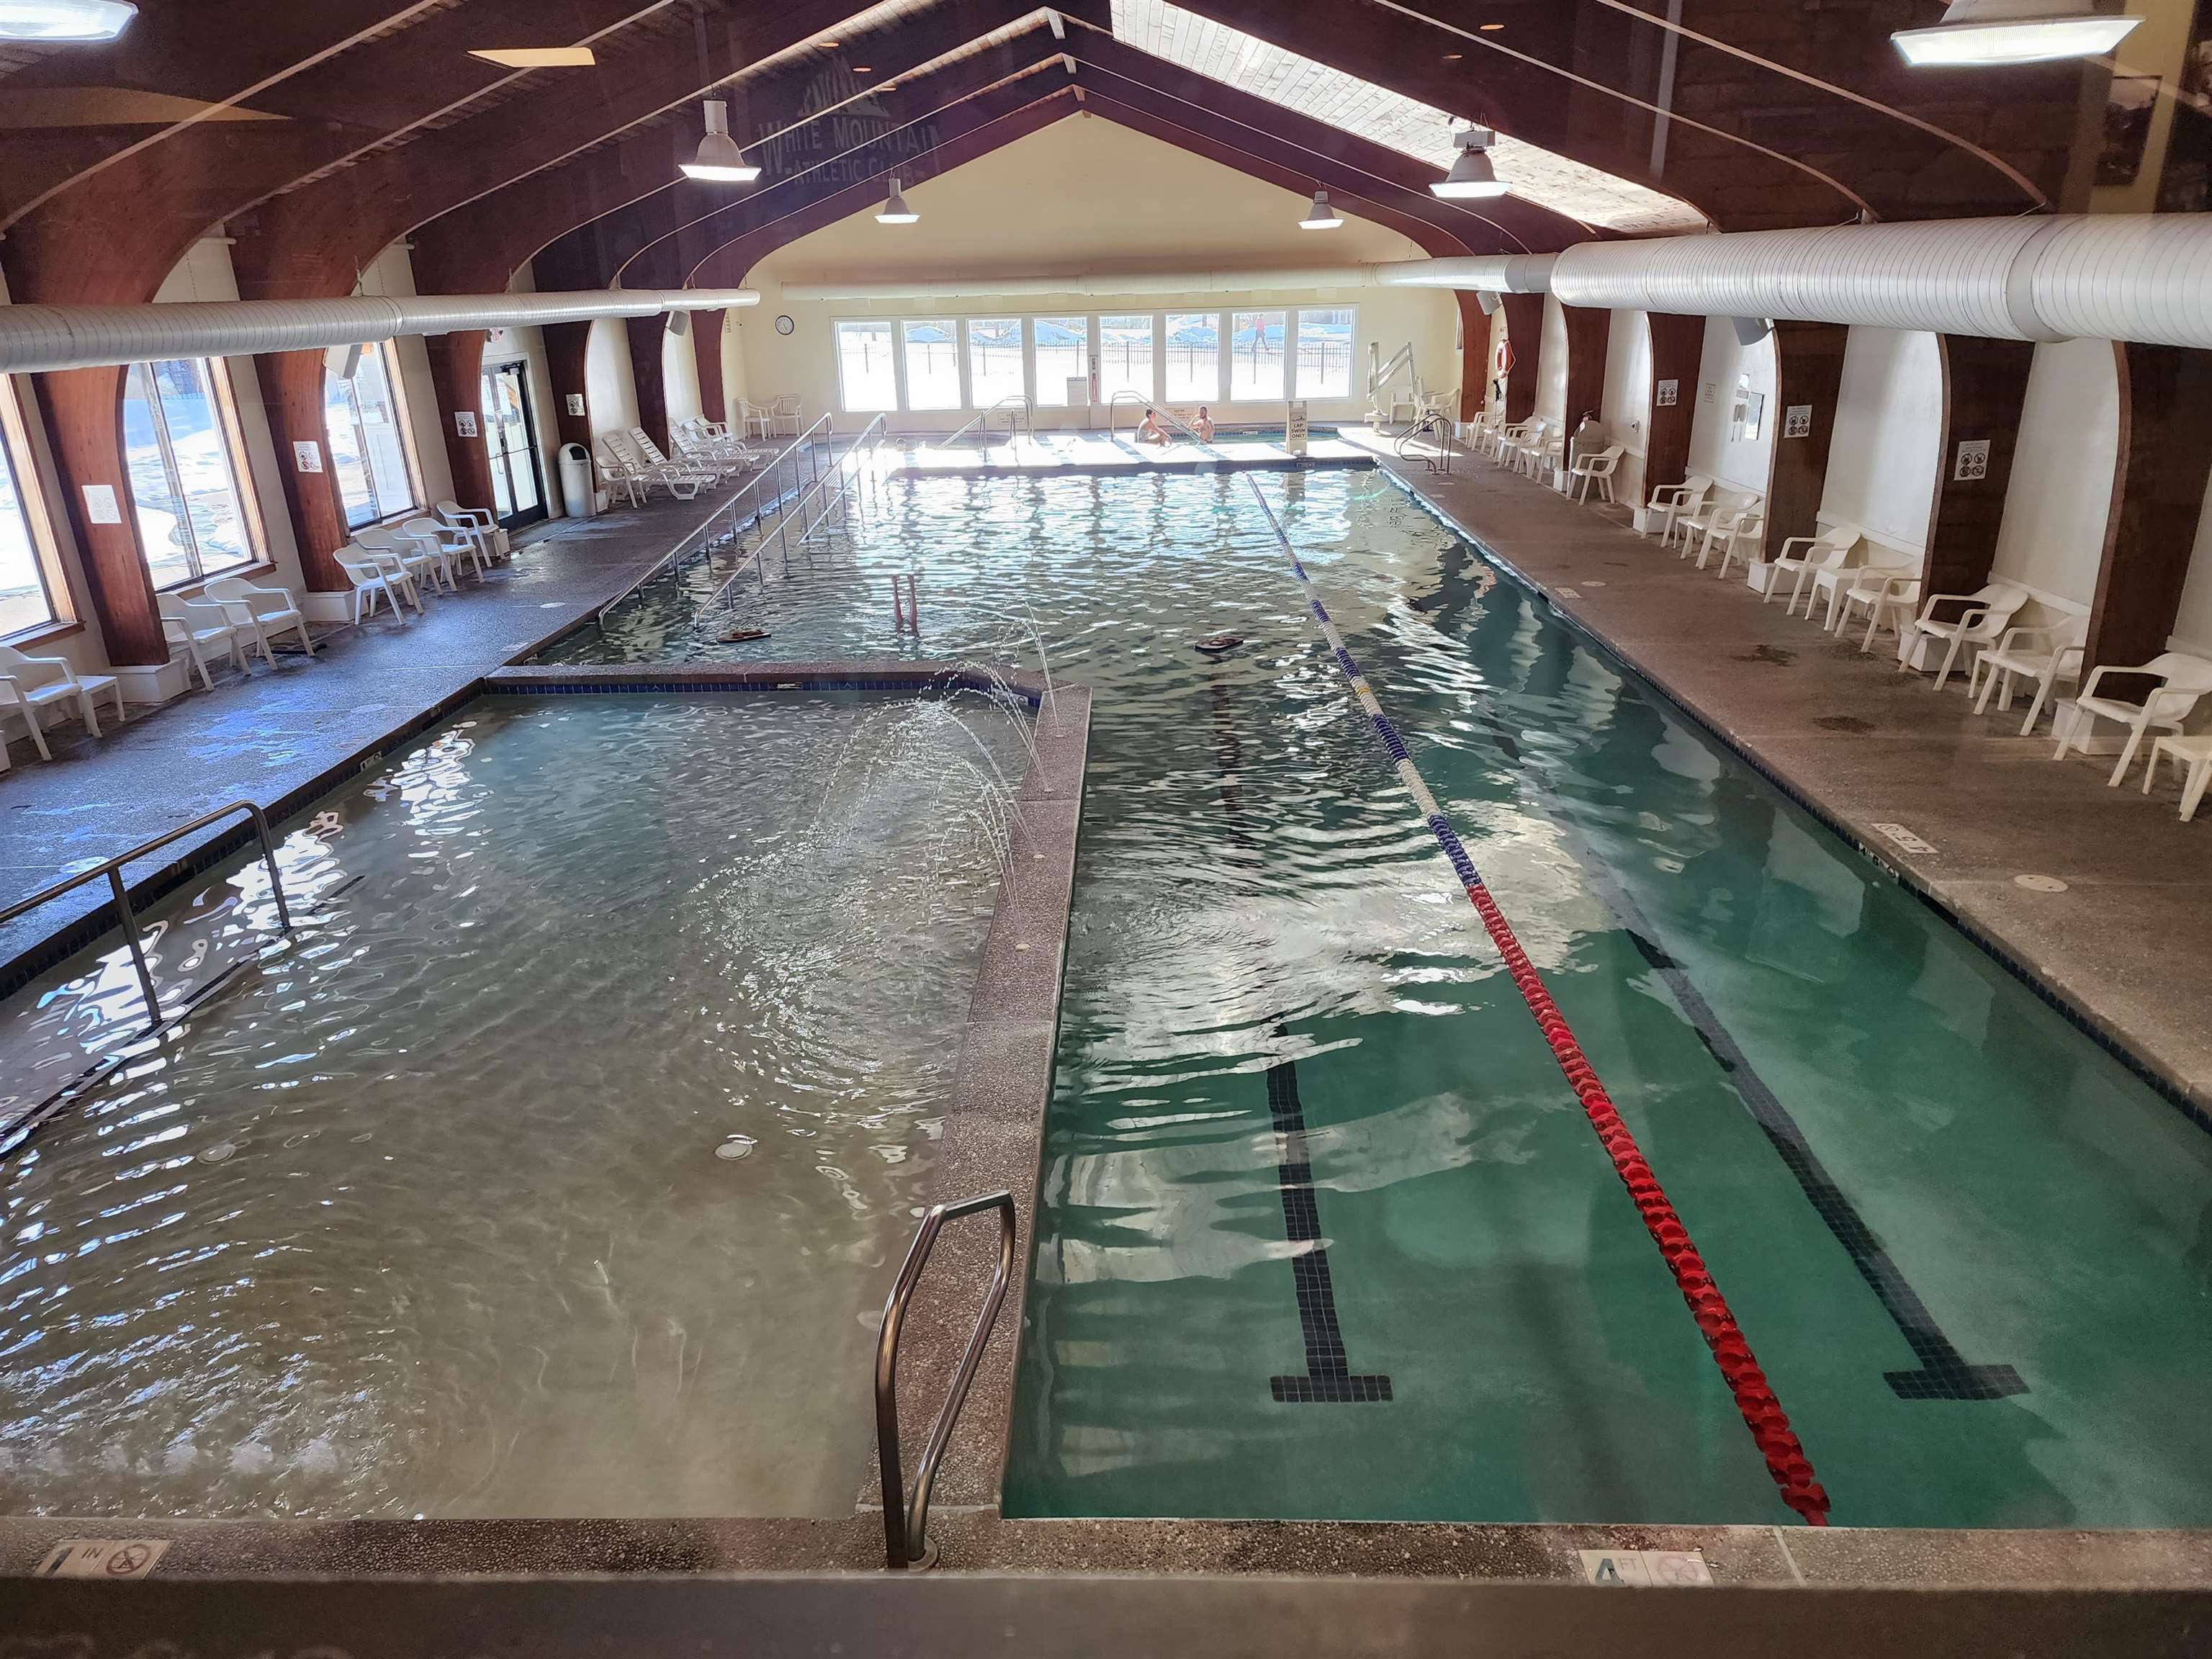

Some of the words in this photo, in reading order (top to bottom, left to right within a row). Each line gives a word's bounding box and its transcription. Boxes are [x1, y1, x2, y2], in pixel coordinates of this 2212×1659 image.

[757, 120, 822, 176] WHITE
[793, 159, 863, 185] ATHLETIC
[81, 1547, 104, 1559] IN
[1618, 1557, 1637, 1570] FT
